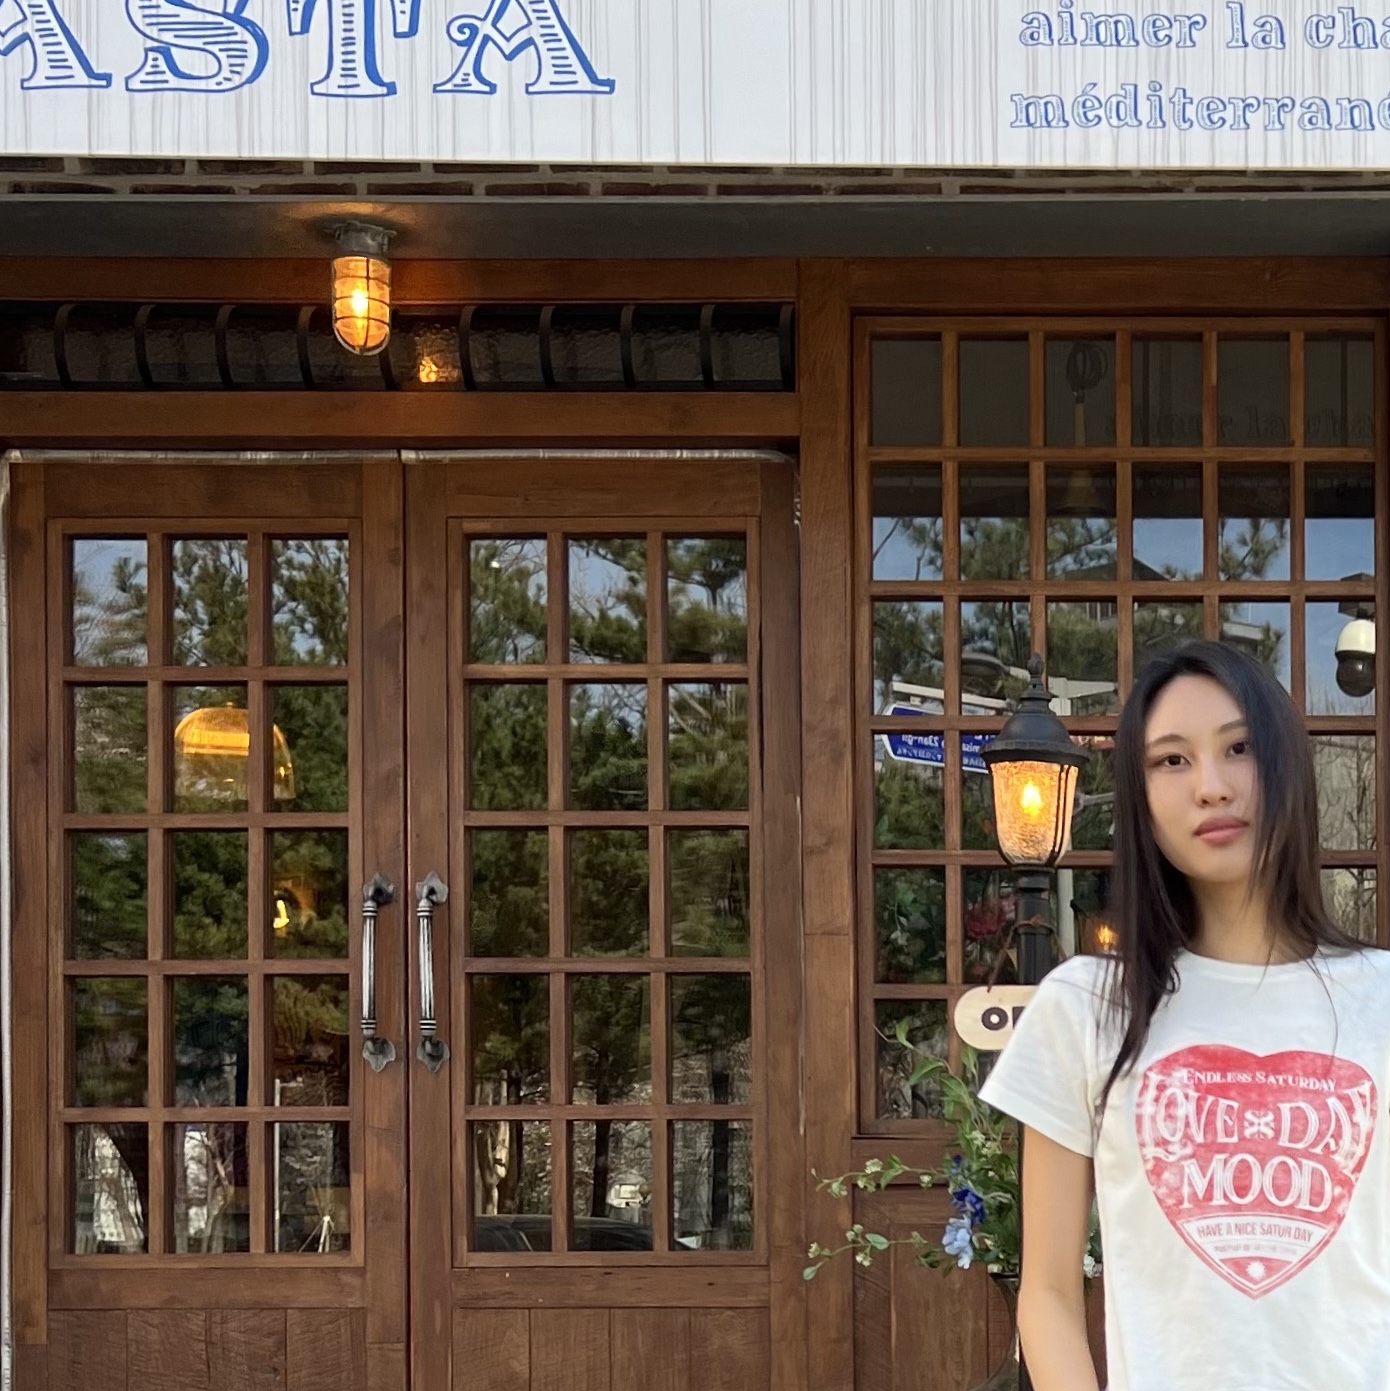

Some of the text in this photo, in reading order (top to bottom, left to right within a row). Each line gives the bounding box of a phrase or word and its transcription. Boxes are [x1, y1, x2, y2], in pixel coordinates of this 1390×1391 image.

[1019, 0, 1207, 48] aimer
[1226, 1, 1286, 50] la
[1183, 1069, 1337, 1093] ENDLESS SATURDAY
[1277, 1080, 1375, 1167] DAY
[1178, 1152, 1334, 1213] MOOD
[1196, 1223, 1224, 1239] HAVE
[1225, 1223, 1233, 1235] A
[1234, 1222, 1256, 1236] NICE
